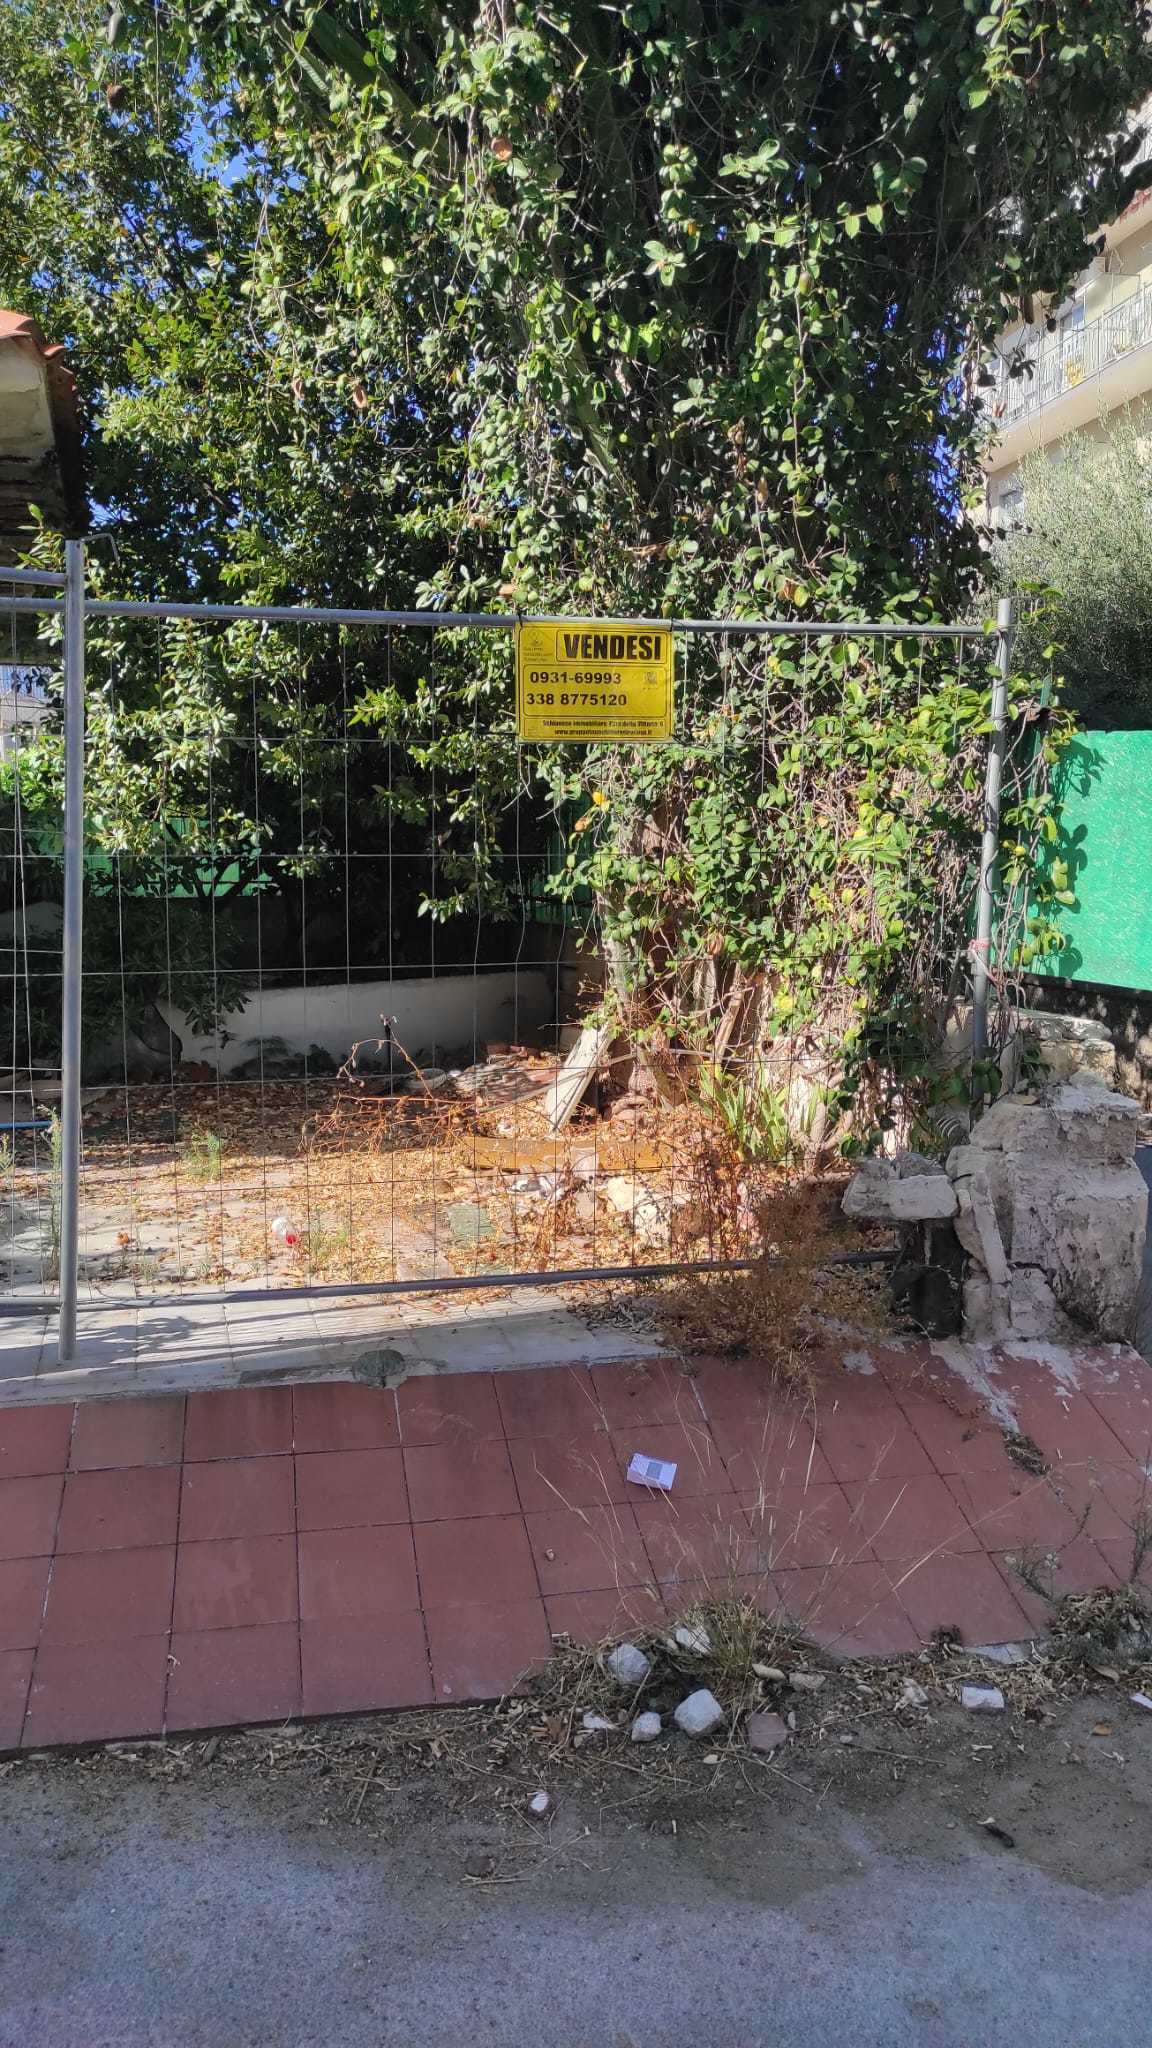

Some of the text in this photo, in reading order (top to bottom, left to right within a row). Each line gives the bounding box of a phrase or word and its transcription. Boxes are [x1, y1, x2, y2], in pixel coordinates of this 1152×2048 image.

[564, 633, 661, 660] VENDESI
[530, 671, 621, 684] 0931-69993
[526, 693, 627, 706] 338 8775120
